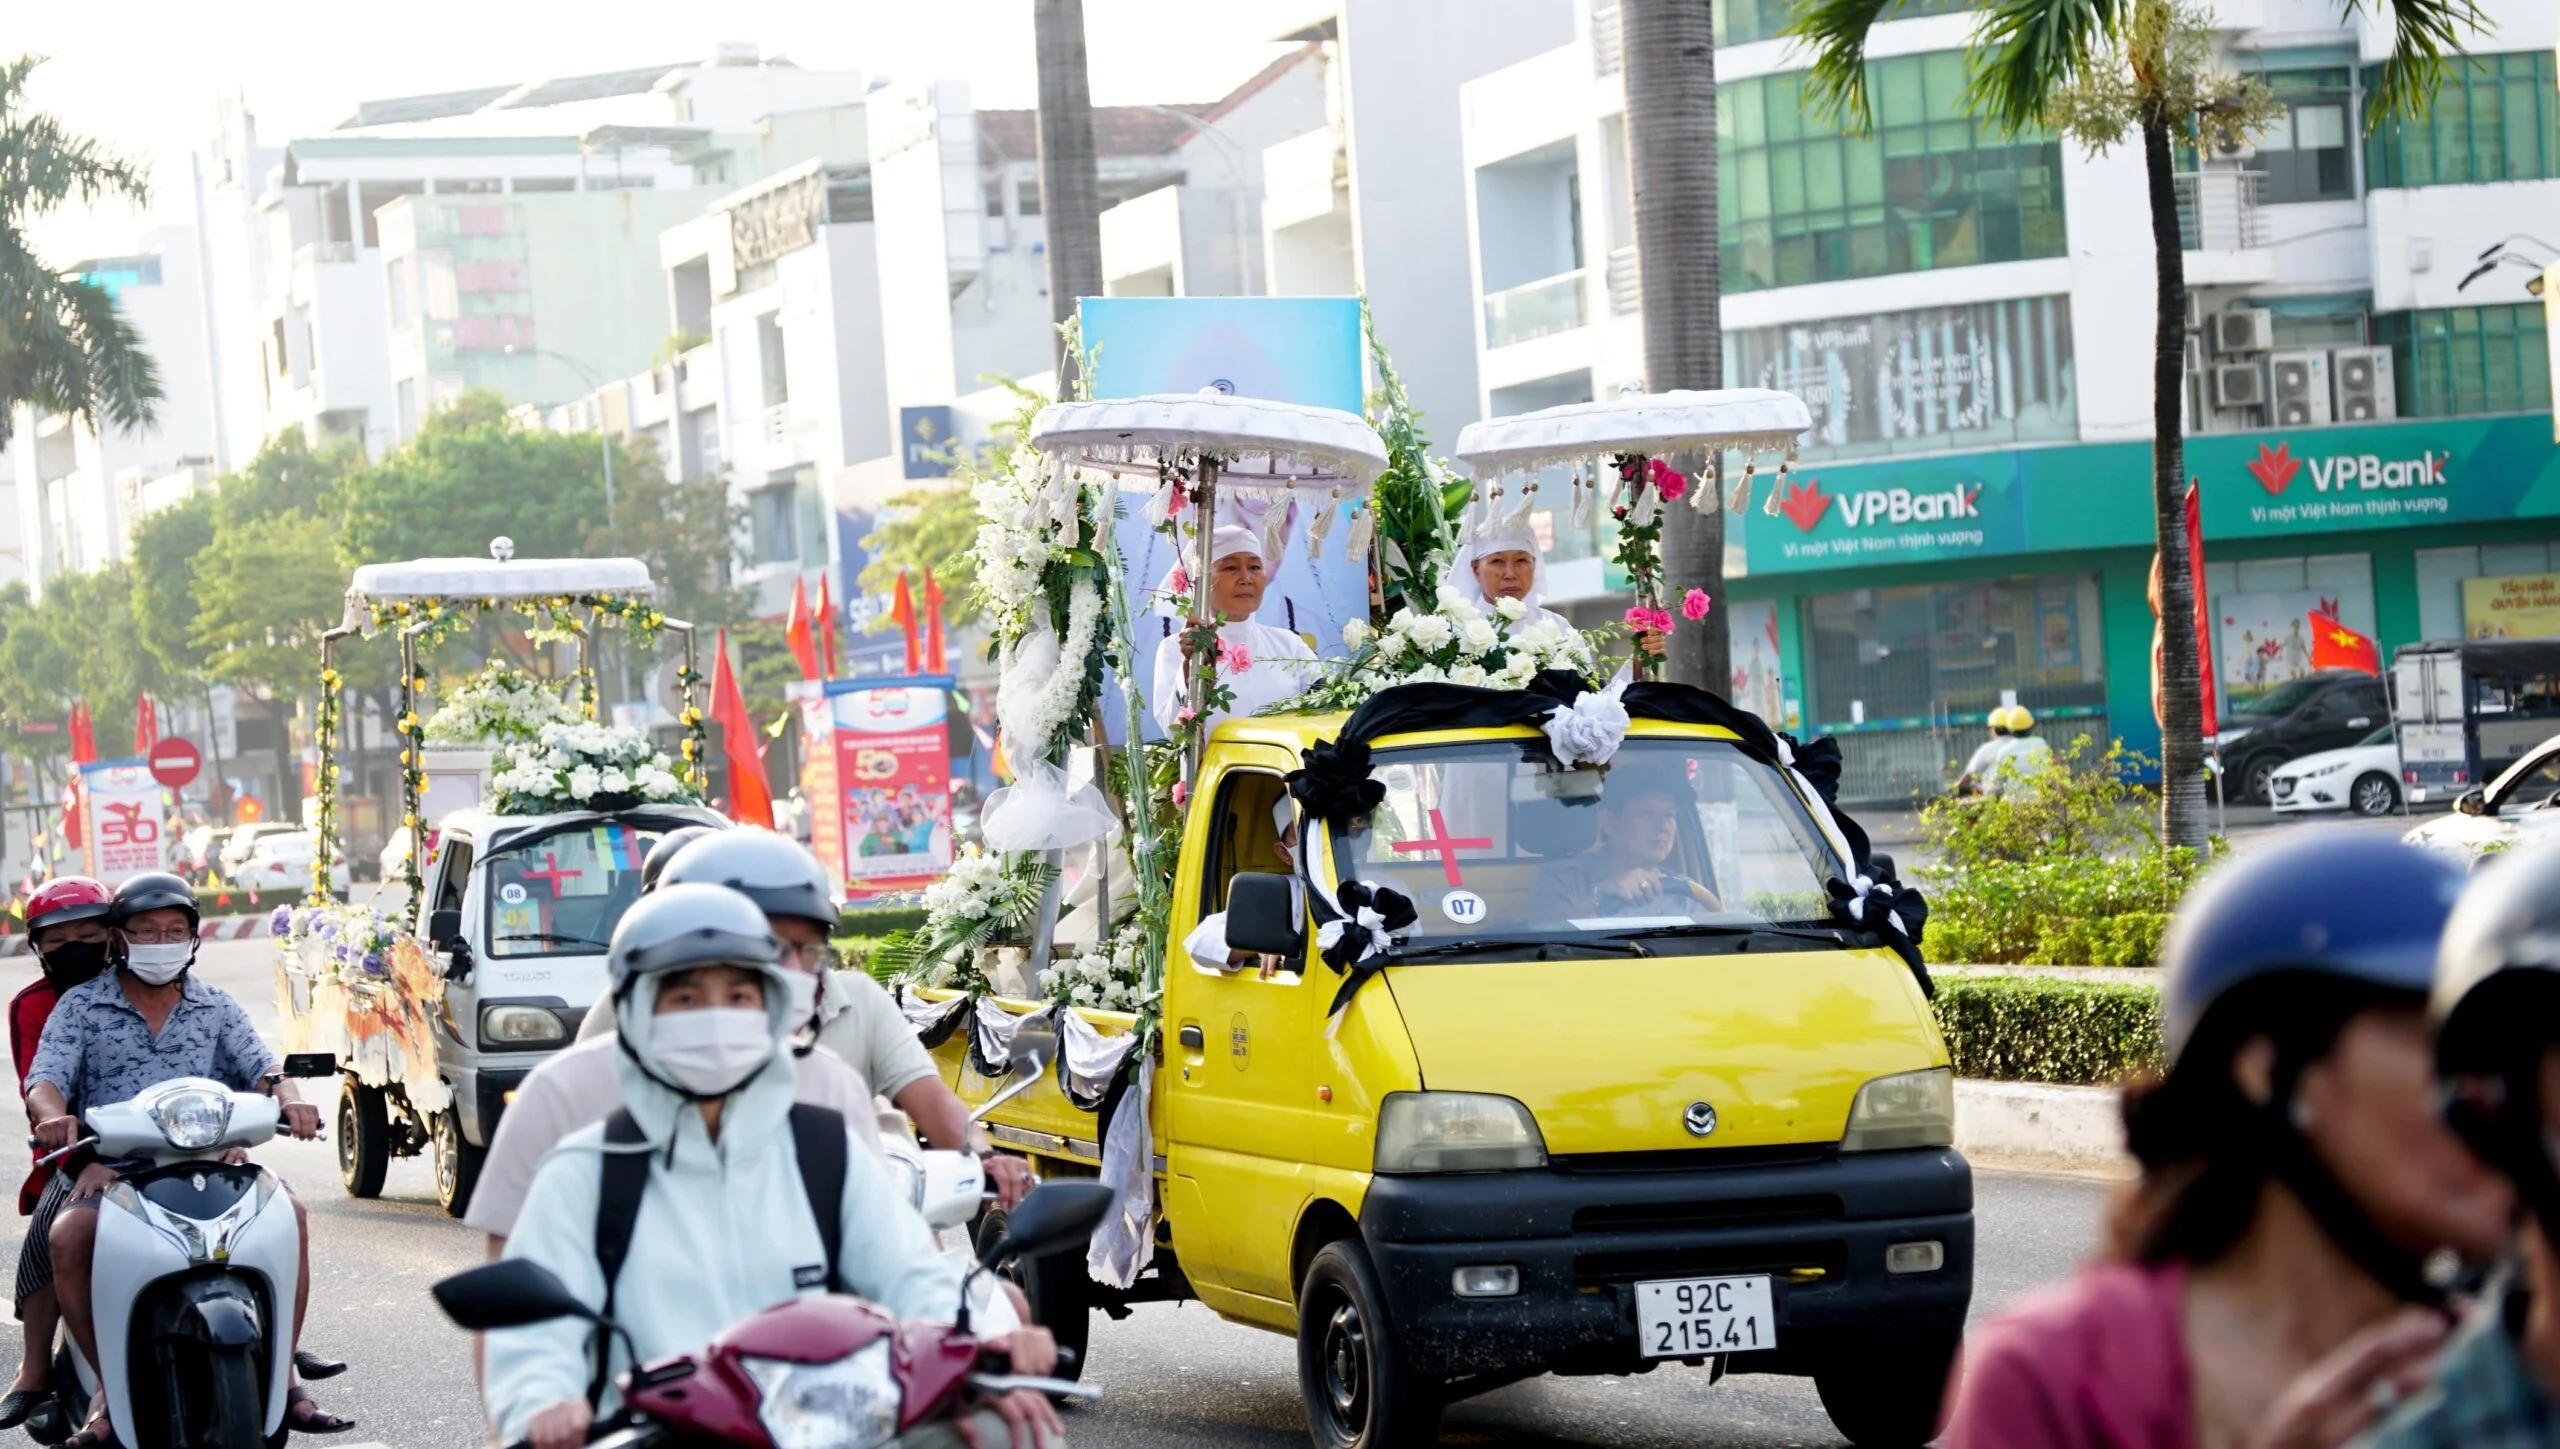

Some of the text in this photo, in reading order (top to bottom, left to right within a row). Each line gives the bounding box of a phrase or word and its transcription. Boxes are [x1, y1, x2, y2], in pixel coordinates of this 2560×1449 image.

[2308, 450, 2450, 493] VPBank
[1837, 483, 1983, 528] VPBank
[2269, 504, 2296, 523] một
[2299, 501, 2327, 521] Việt
[2330, 501, 2363, 517] Nam
[2366, 498, 2400, 516] thịnh
[1831, 536, 1859, 556] Việt
[1862, 535, 1895, 551] Nam
[1897, 531, 1935, 551] thịnh
[506, 887, 522, 899] 08
[1452, 899, 1475, 915] 07
[1676, 1283, 1733, 1314] 92C
[1656, 1316, 1757, 1352] 215.41
